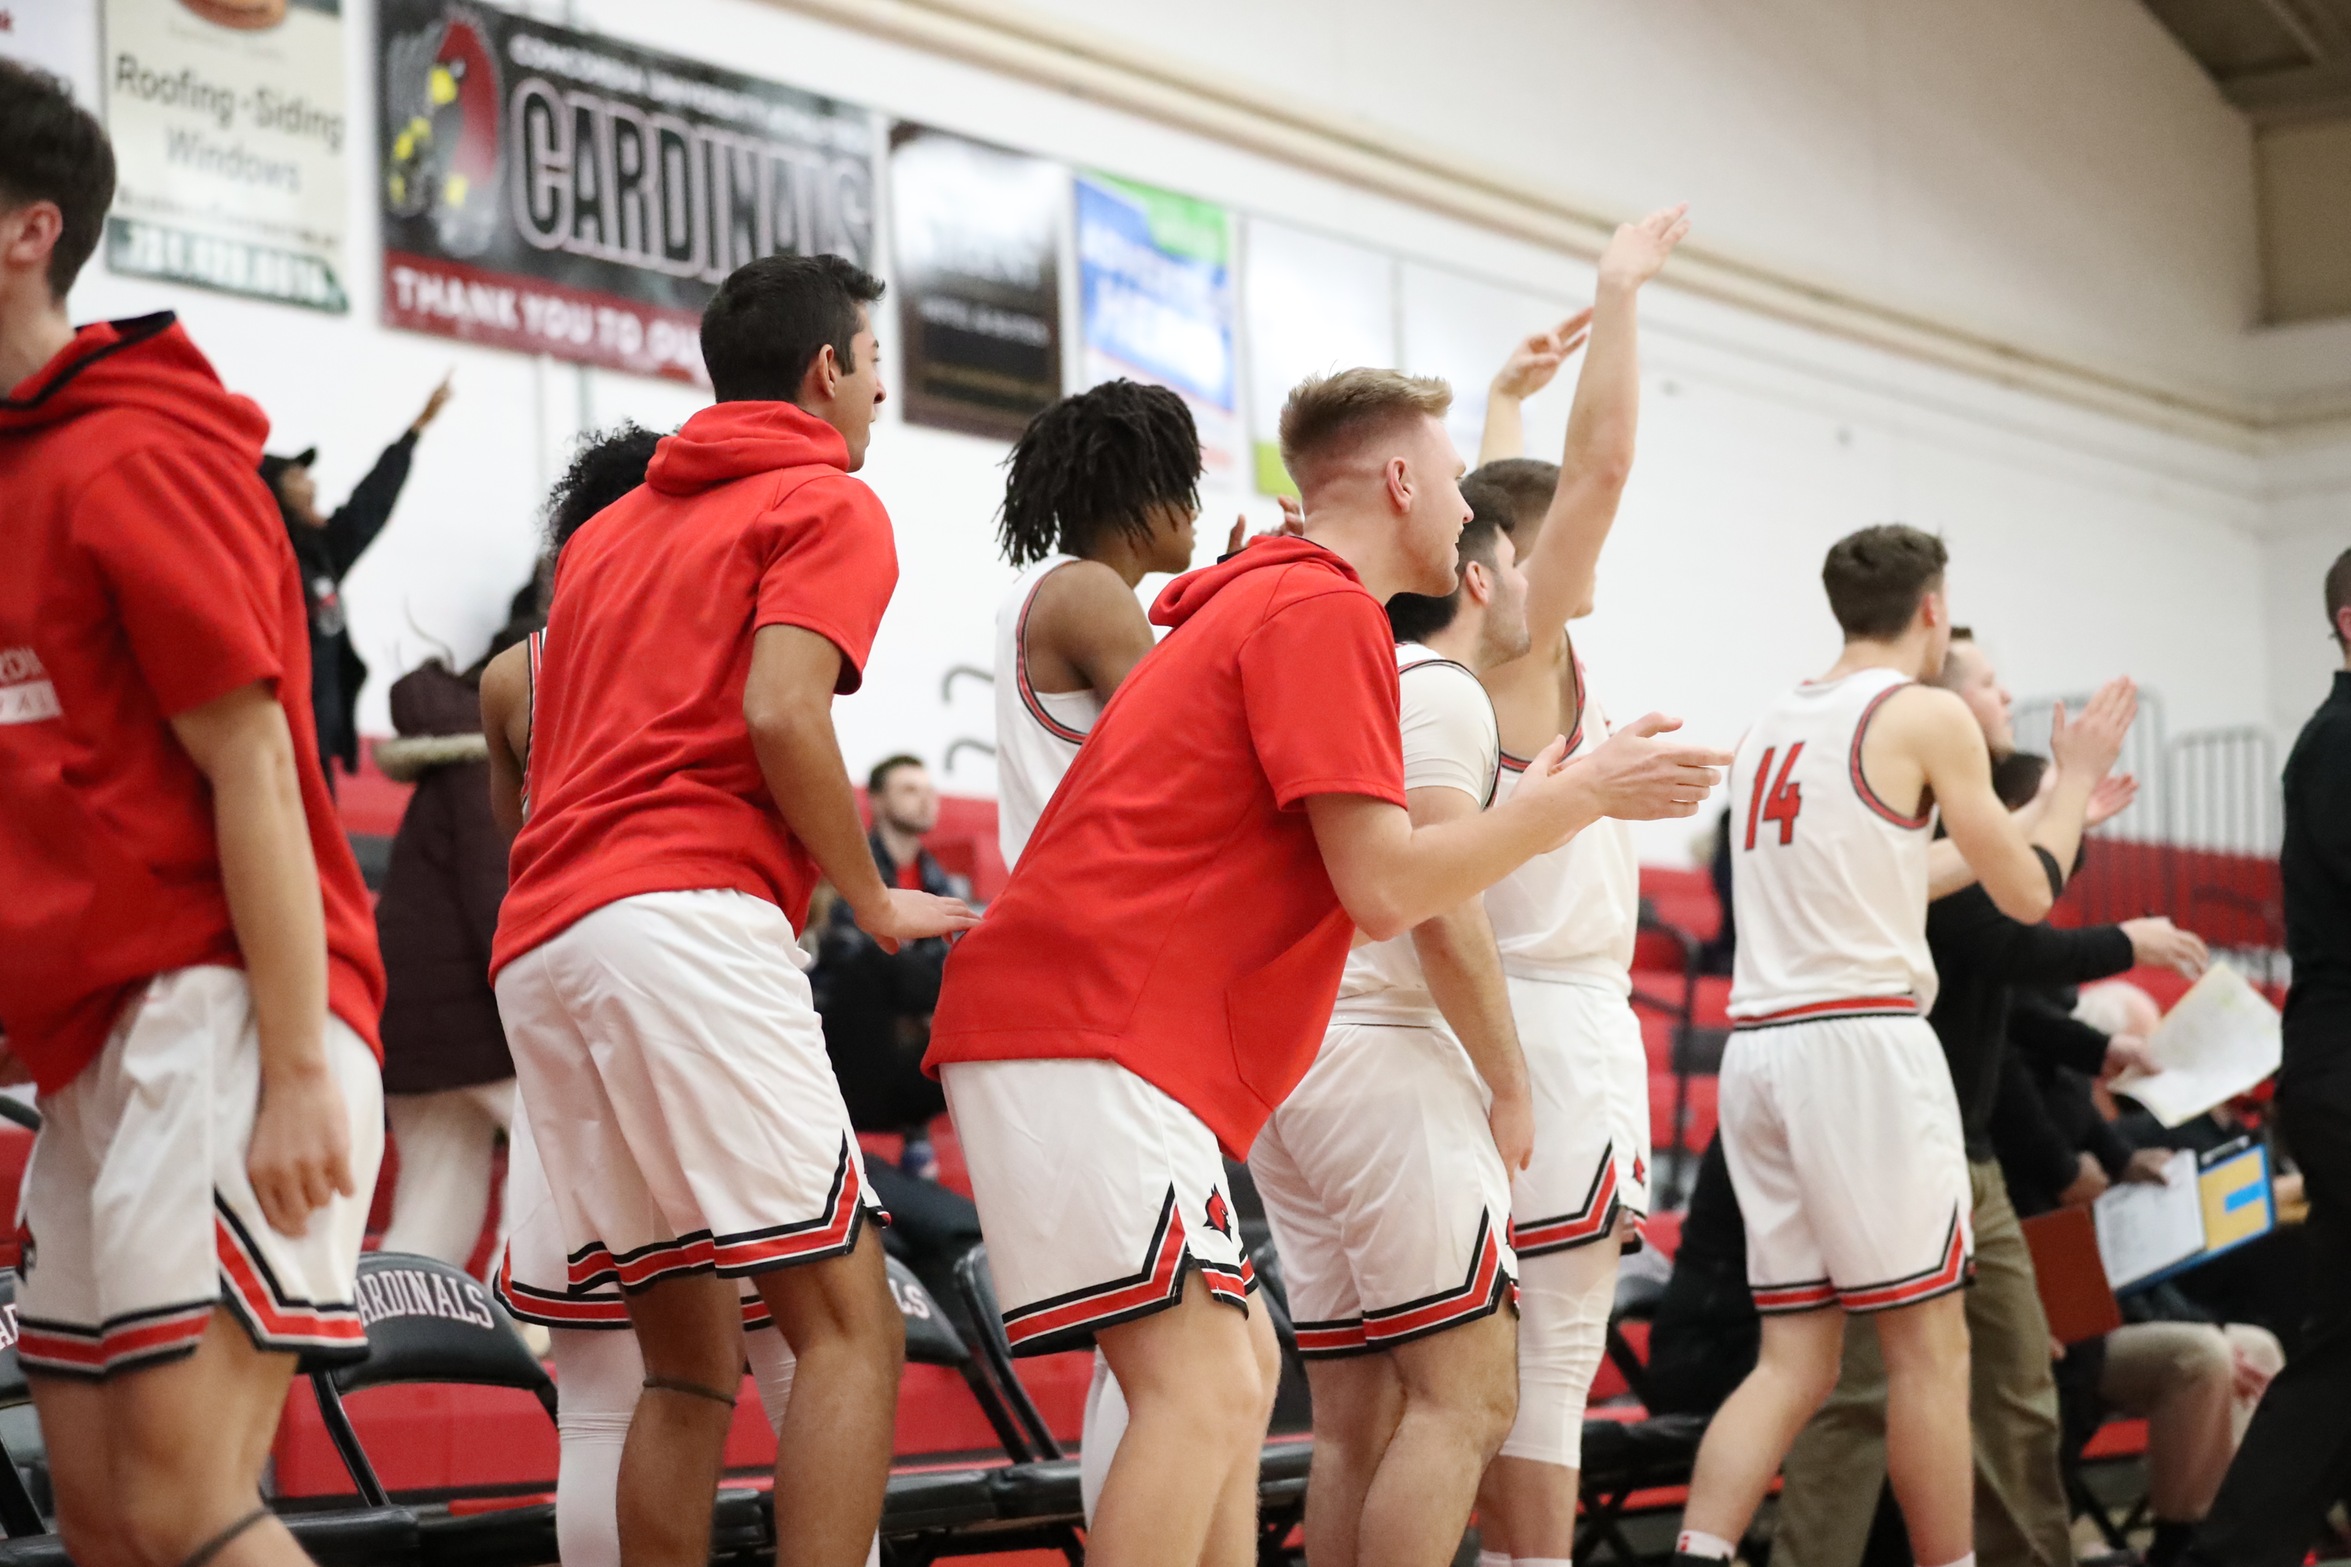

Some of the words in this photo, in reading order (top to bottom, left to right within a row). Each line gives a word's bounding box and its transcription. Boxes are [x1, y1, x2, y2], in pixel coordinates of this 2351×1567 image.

[115, 53, 235, 131] Roofing
[256, 86, 345, 156] Siding
[165, 125, 301, 194] Windows
[511, 78, 874, 284] CARDINALS
[393, 266, 519, 331] THANK
[520, 290, 594, 346] YOU
[597, 305, 644, 356] TO
[648, 318, 703, 366] OU
[1744, 741, 1805, 851] 14
[353, 1269, 495, 1330] ARDINALS
